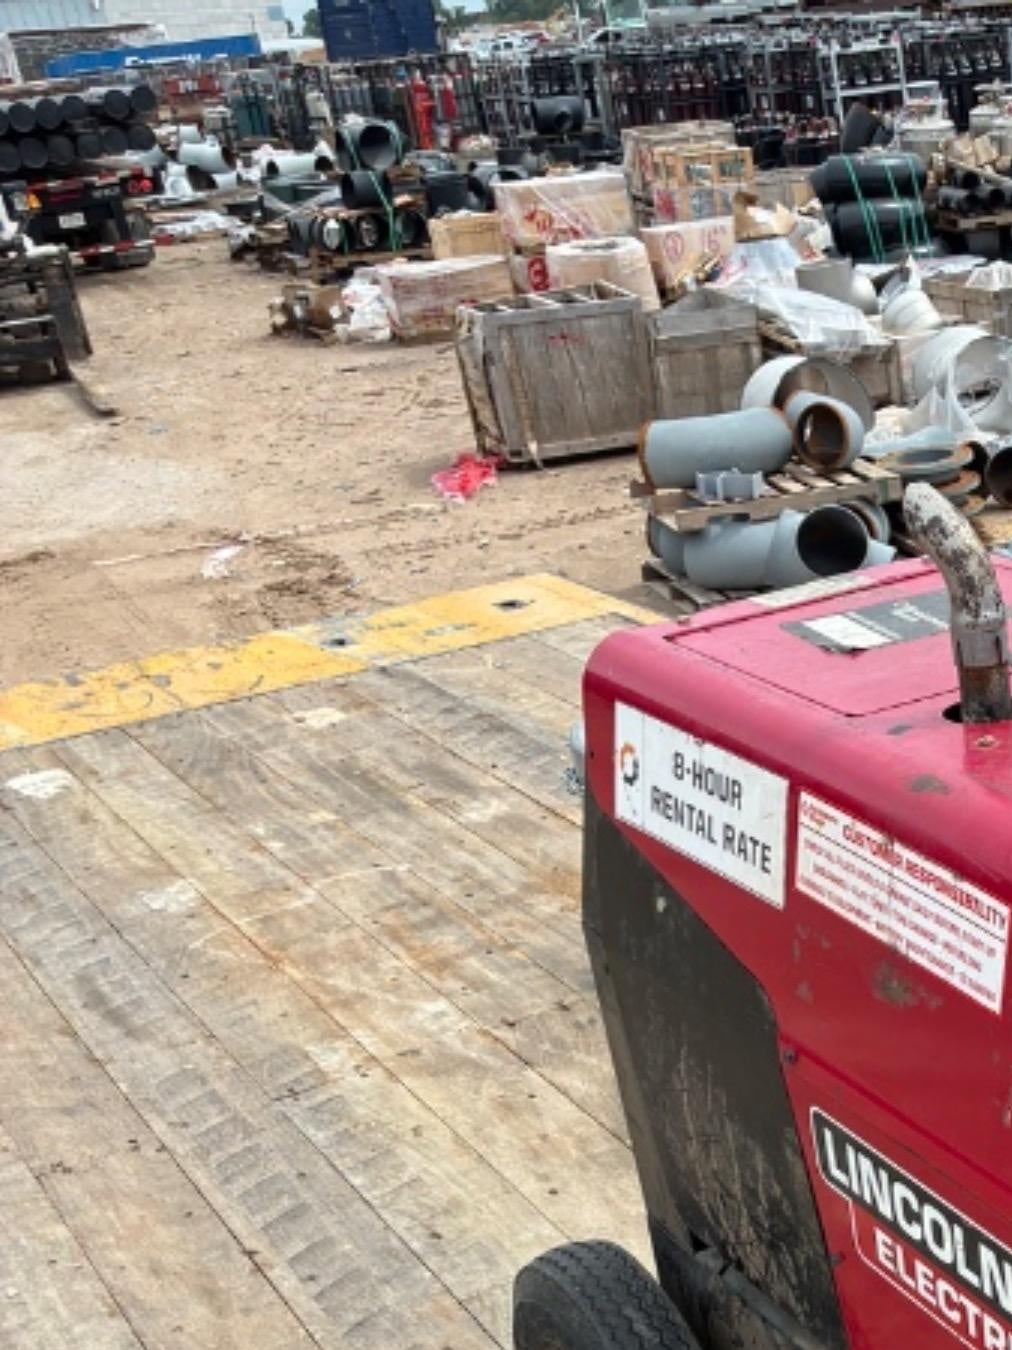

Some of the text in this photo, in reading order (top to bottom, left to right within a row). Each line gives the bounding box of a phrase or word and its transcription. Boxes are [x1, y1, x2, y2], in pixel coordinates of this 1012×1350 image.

[672, 752, 743, 811] 8-HOUR
[651, 785, 772, 875] RENTAL RATE
[842, 823, 904, 868] CUSTOMER
[904, 856, 1007, 931] RESPONSIBILITY
